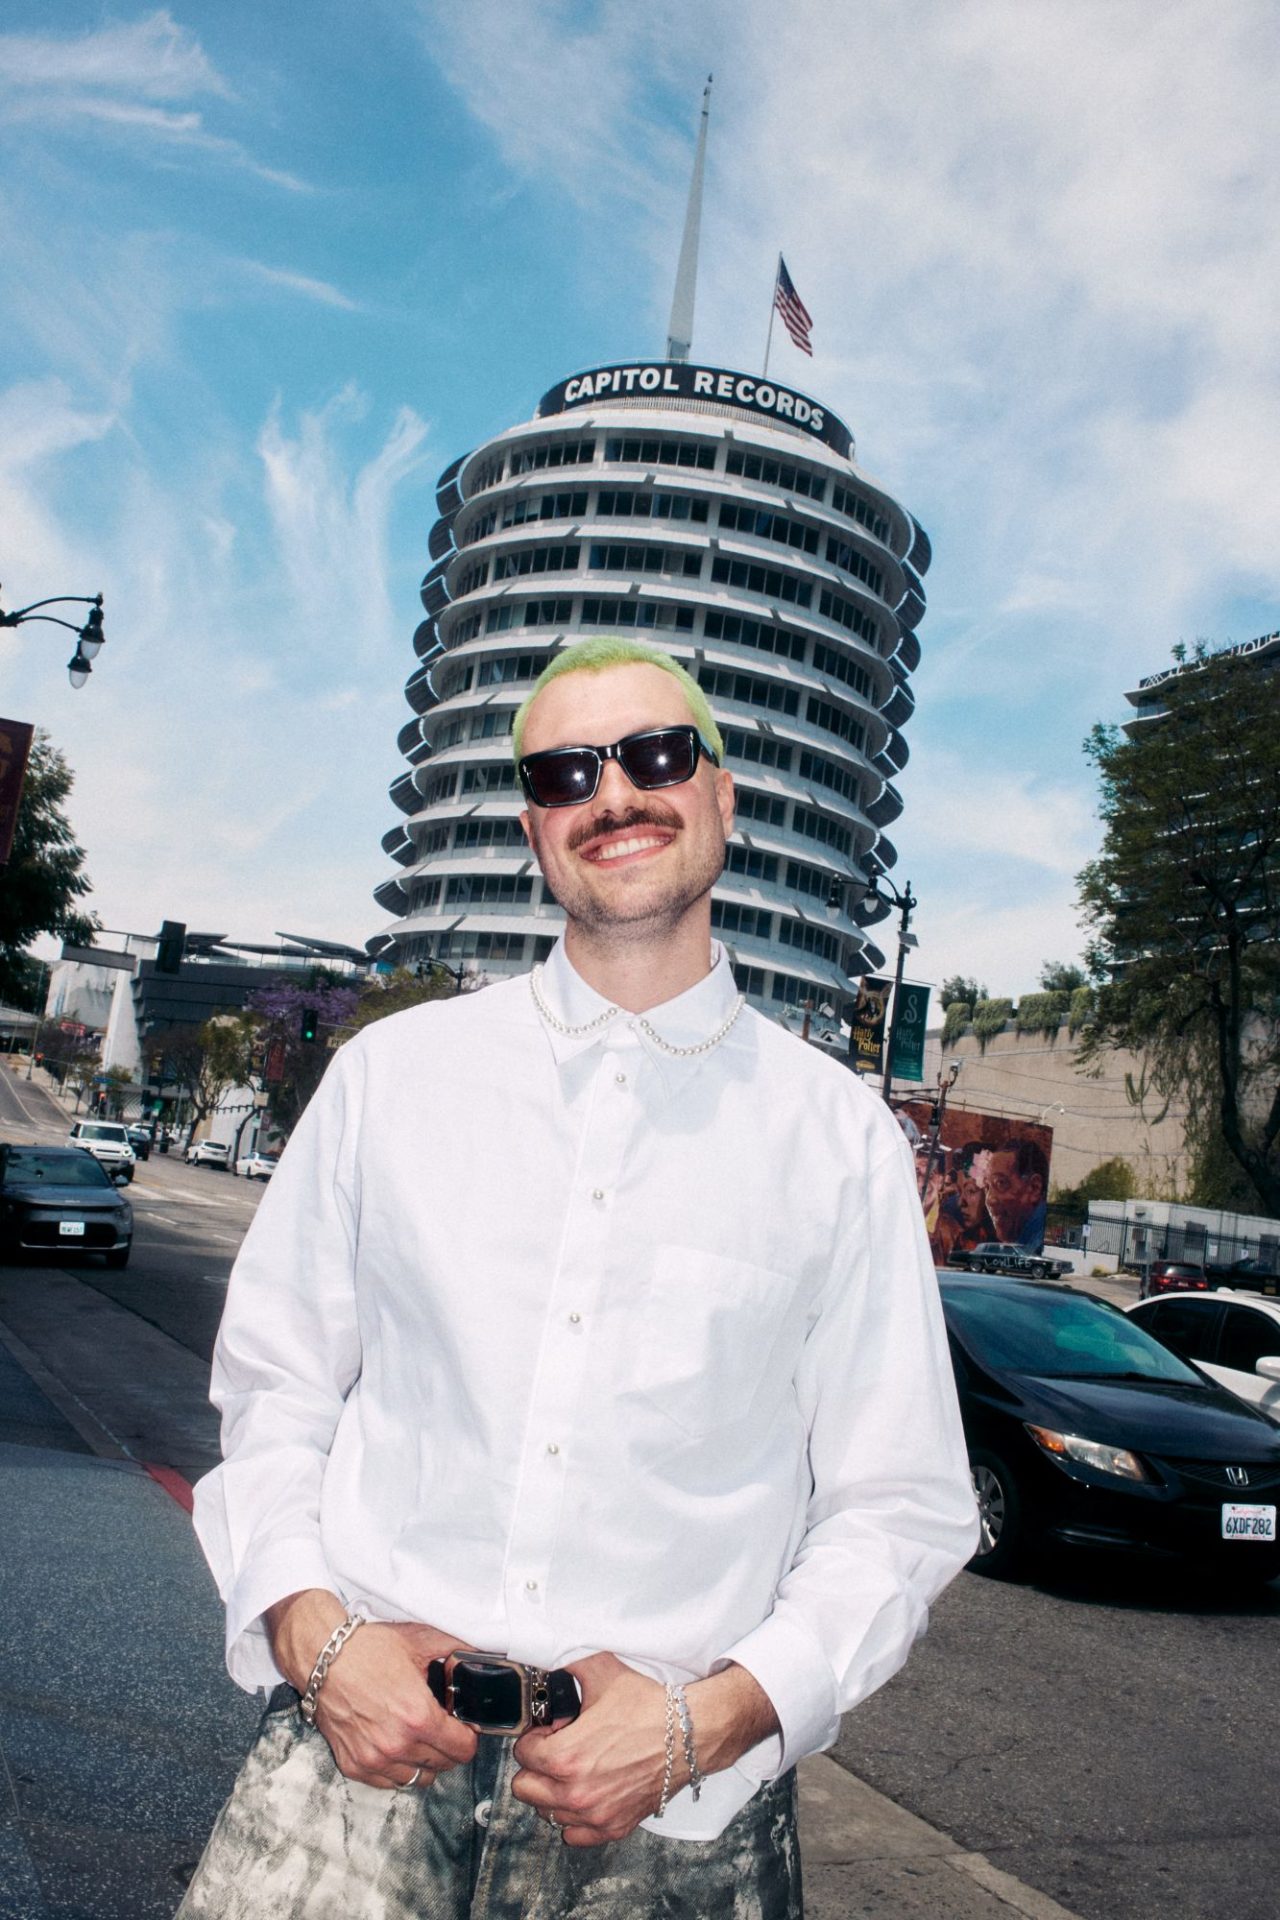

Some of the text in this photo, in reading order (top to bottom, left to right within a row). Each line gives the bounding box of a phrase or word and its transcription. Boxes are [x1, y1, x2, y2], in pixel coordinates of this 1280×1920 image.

[564, 367, 824, 431] CAPITOL RECORDS
[1226, 1517, 1272, 1535] 6XDF282
